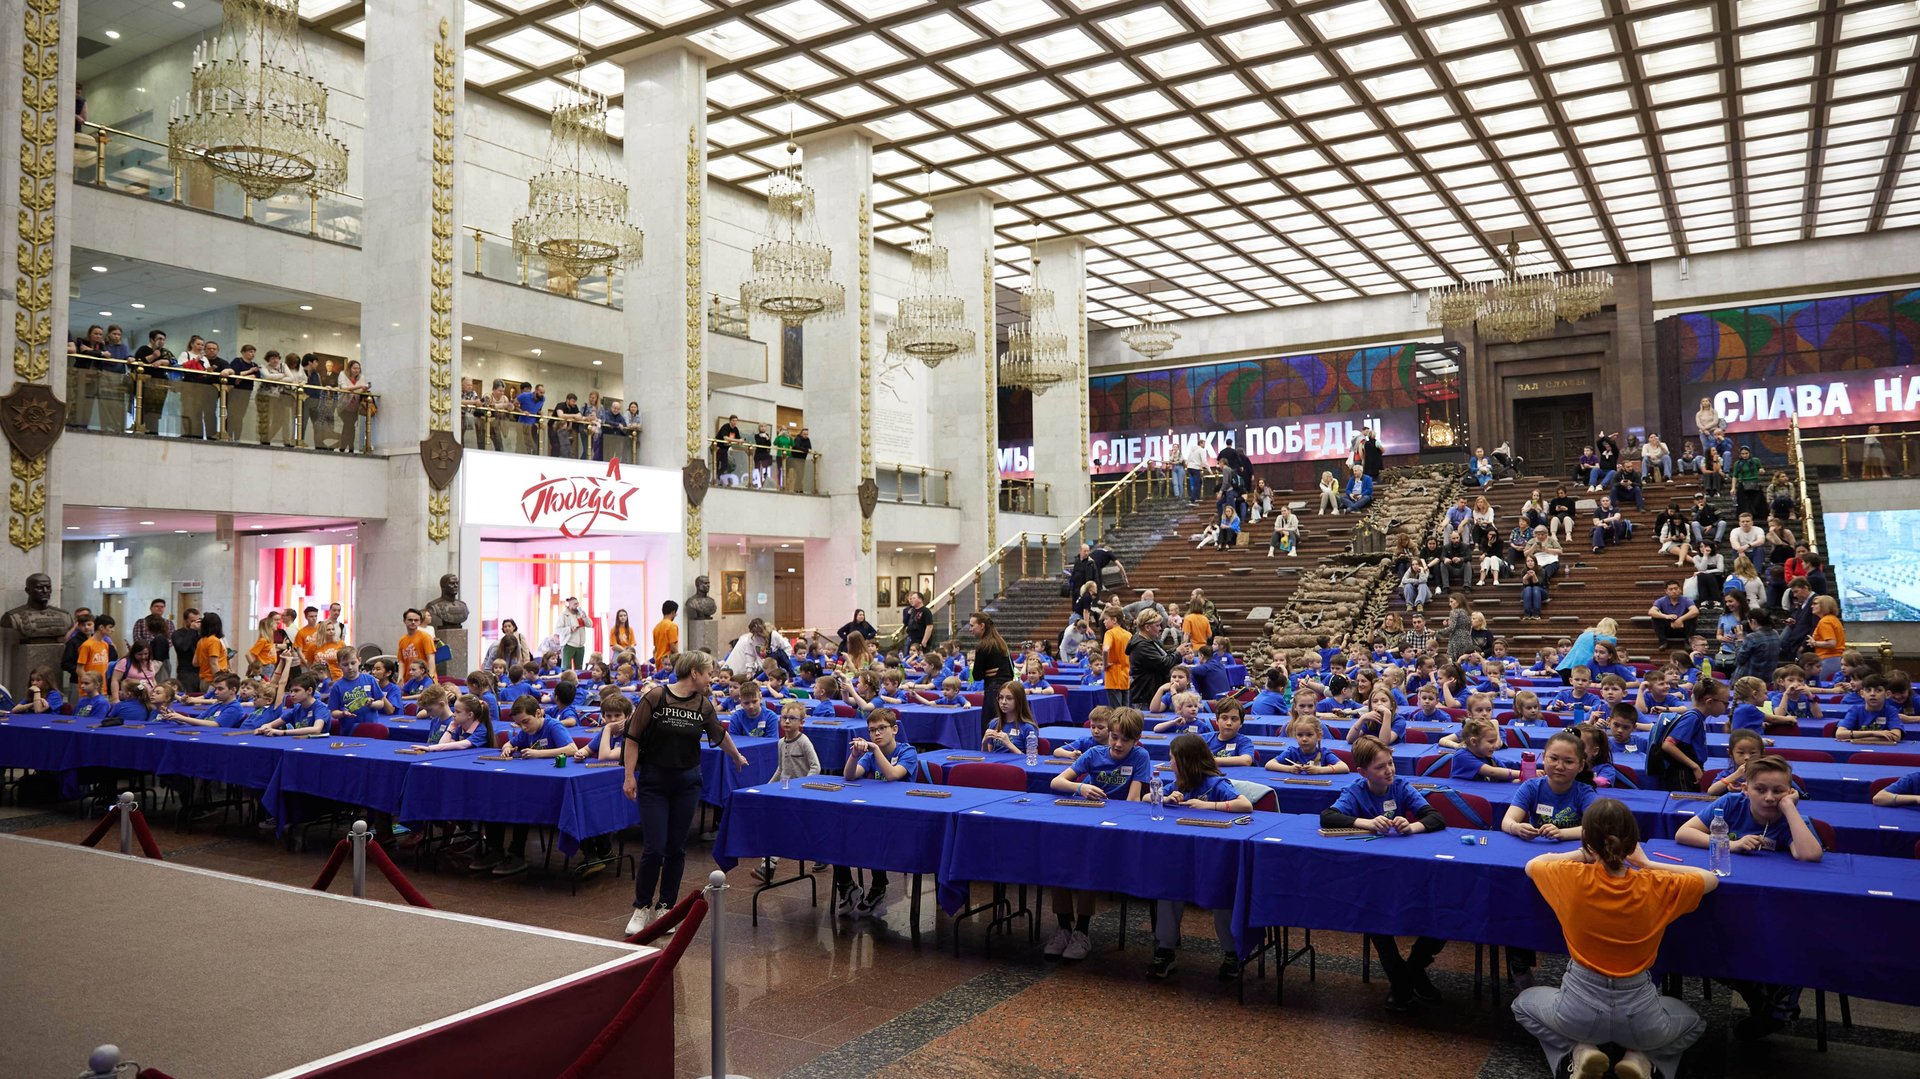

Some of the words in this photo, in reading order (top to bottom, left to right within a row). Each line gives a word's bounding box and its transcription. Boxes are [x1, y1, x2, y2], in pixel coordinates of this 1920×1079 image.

[1517, 382, 1539, 391] ЗАЛ
[1545, 378, 1586, 388] СЛАЫ
[1713, 382, 1853, 423] СЛАВА
[997, 446, 1035, 473] МЫ
